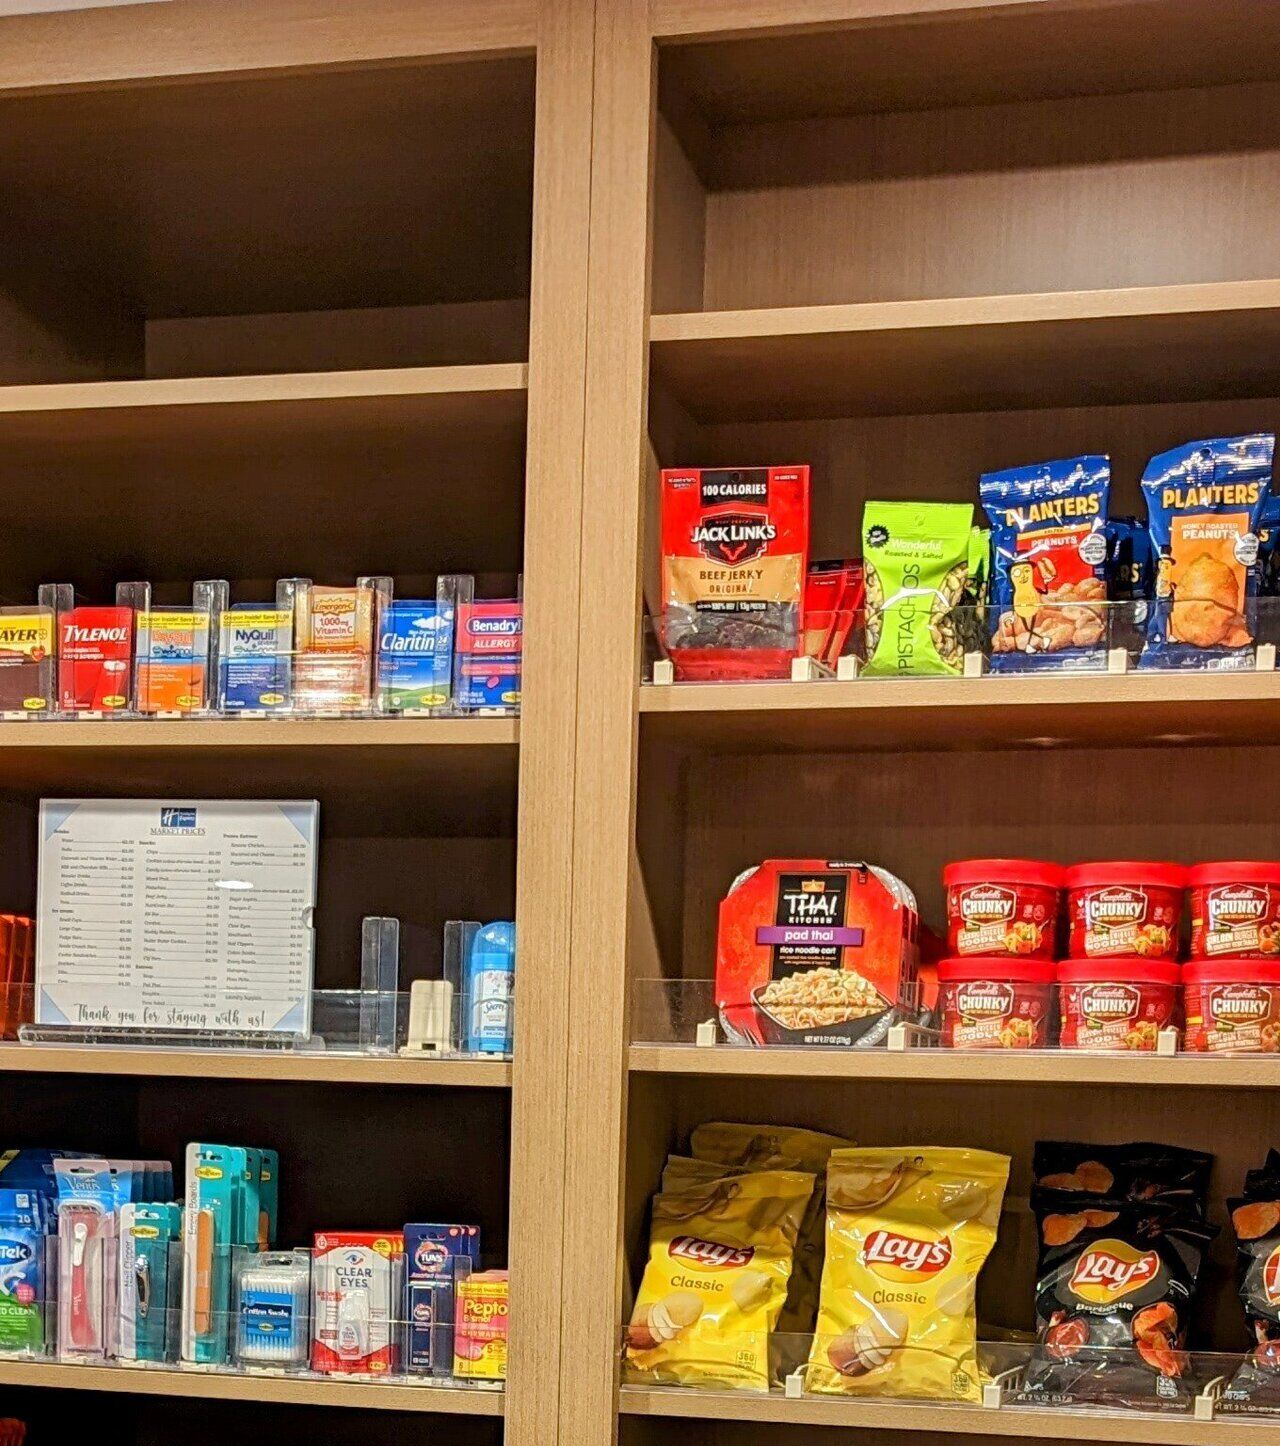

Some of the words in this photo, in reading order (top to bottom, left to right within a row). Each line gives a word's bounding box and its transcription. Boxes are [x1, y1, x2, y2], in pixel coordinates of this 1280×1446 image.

[702, 485, 719, 496] 100
[720, 483, 767, 495] CALORIES
[1162, 482, 1260, 509] PLANTERS
[1006, 496, 1101, 527] PLANTERS
[1182, 529, 1238, 540] PEANUTS
[891, 538, 942, 551] Wonderful
[700, 571, 724, 580] BEEF
[725, 569, 764, 580] JERKY
[64, 624, 128, 642] TYLENOL
[235, 629, 275, 645] NyQuil
[381, 631, 436, 652] Claritin
[473, 638, 518, 648] ALLERGY
[150, 828, 179, 836] MARKET
[180, 828, 206, 836] PRICES
[783, 894, 837, 915] THAI
[962, 899, 1012, 916] CHUNKY
[1090, 900, 1142, 917] CHUNKY
[1212, 900, 1266, 915] CHUNKY
[784, 930, 808, 942] pad
[811, 929, 834, 941] thai
[958, 995, 1008, 1012] CHUNKY
[1083, 997, 1136, 1014] CHUNKY
[73, 1003, 110, 1022] Thank
[118, 1010, 136, 1024] you
[143, 1006, 159, 1024] for
[166, 1009, 207, 1026] staying
[215, 1007, 242, 1025] with
[248, 1009, 265, 1026] us!
[671, 1235, 753, 1267] Lay's
[866, 1231, 949, 1272] Lay's
[336, 1266, 371, 1278] CLEAR
[1073, 1253, 1155, 1292] Lay's
[340, 1277, 368, 1289] EYES
[670, 1275, 725, 1293] Classic
[872, 1290, 927, 1306] Classic
[464, 1299, 508, 1317] Pepto
[1076, 1302, 1133, 1312] Barbecue
